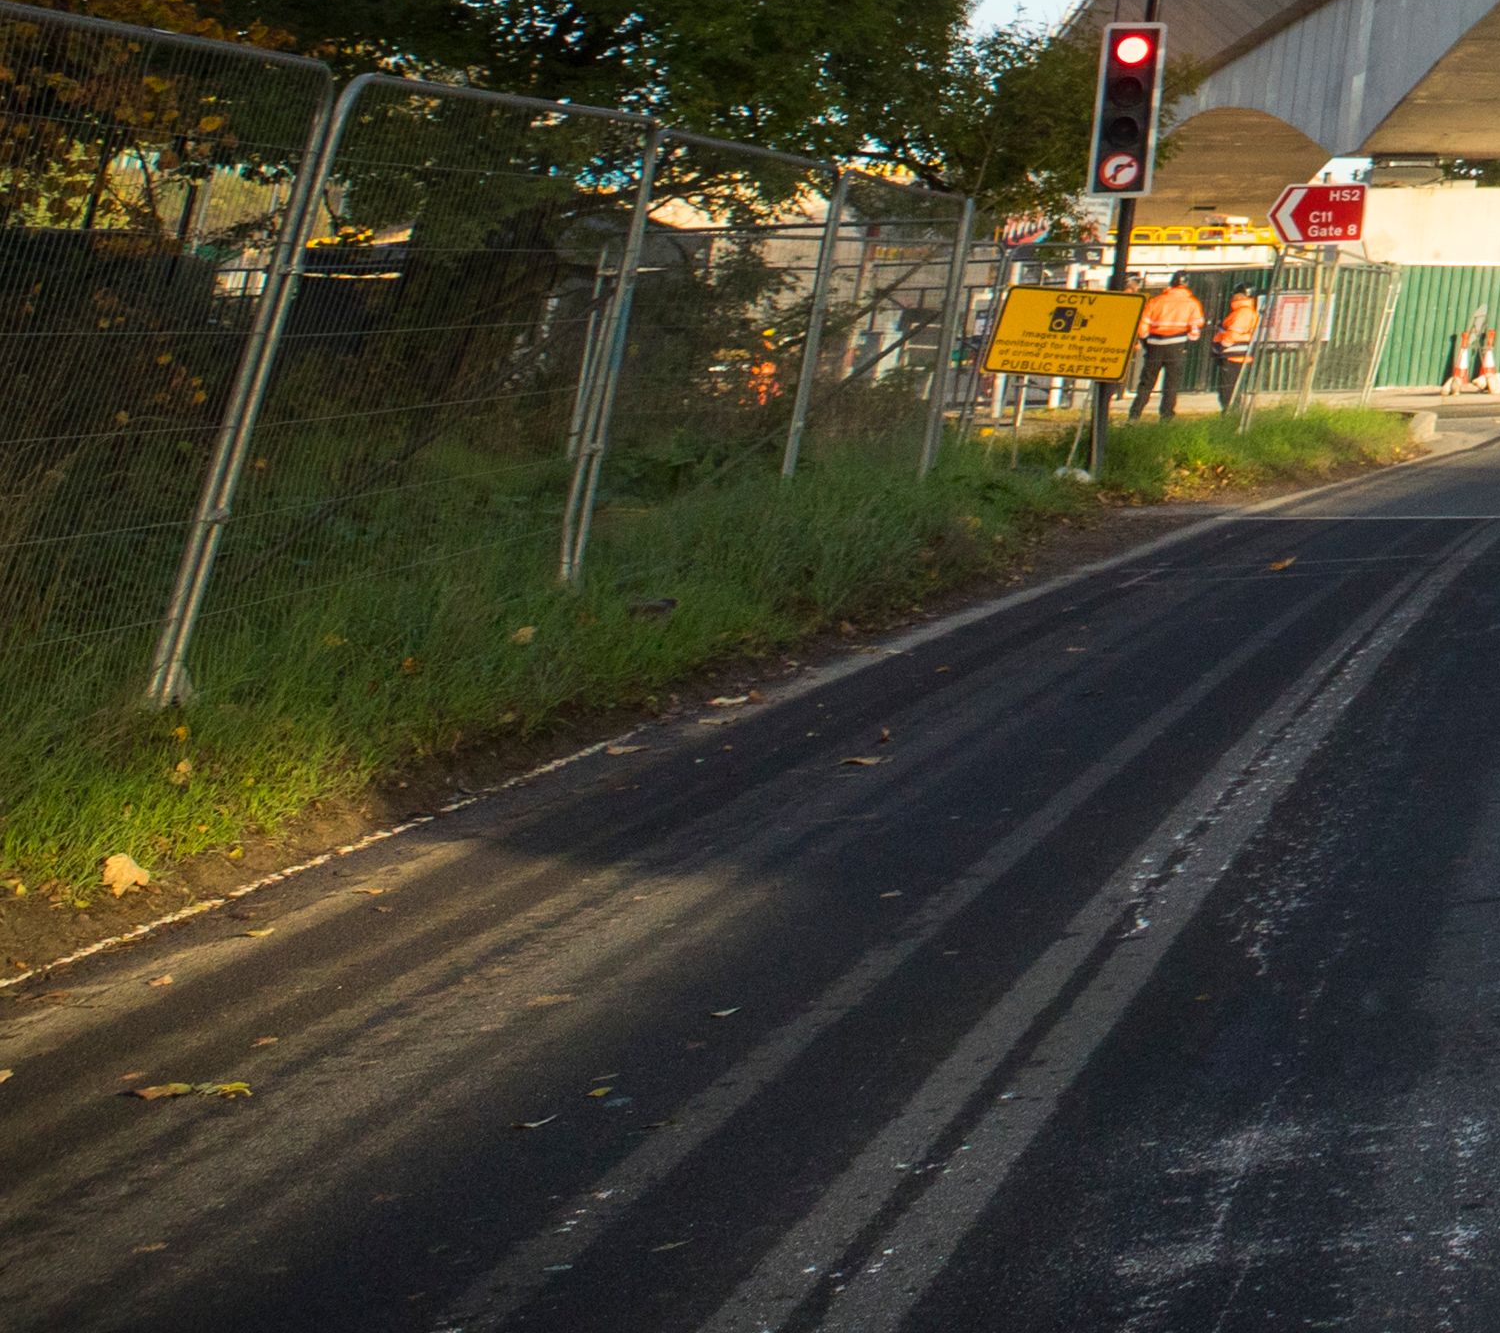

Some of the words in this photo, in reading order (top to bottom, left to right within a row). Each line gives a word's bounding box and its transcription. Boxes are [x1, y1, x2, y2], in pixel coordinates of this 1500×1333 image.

[1329, 189, 1361, 202] HS2
[1308, 211, 1333, 223] C11
[1307, 225, 1343, 237] Gate
[1346, 224, 1358, 236] 8
[1056, 294, 1098, 306] CCTV
[1080, 334, 1108, 345] being
[996, 339, 1048, 350] monitored
[1050, 342, 1065, 350] for
[1068, 343, 1084, 352] the
[1086, 345, 1127, 355] purpose
[999, 348, 1011, 356] of
[1012, 349, 1041, 358] crime
[1043, 352, 1098, 362] prevention
[1100, 356, 1120, 364] and
[1001, 359, 1053, 372] PUBLIC
[1056, 362, 1109, 376] SAFETY
